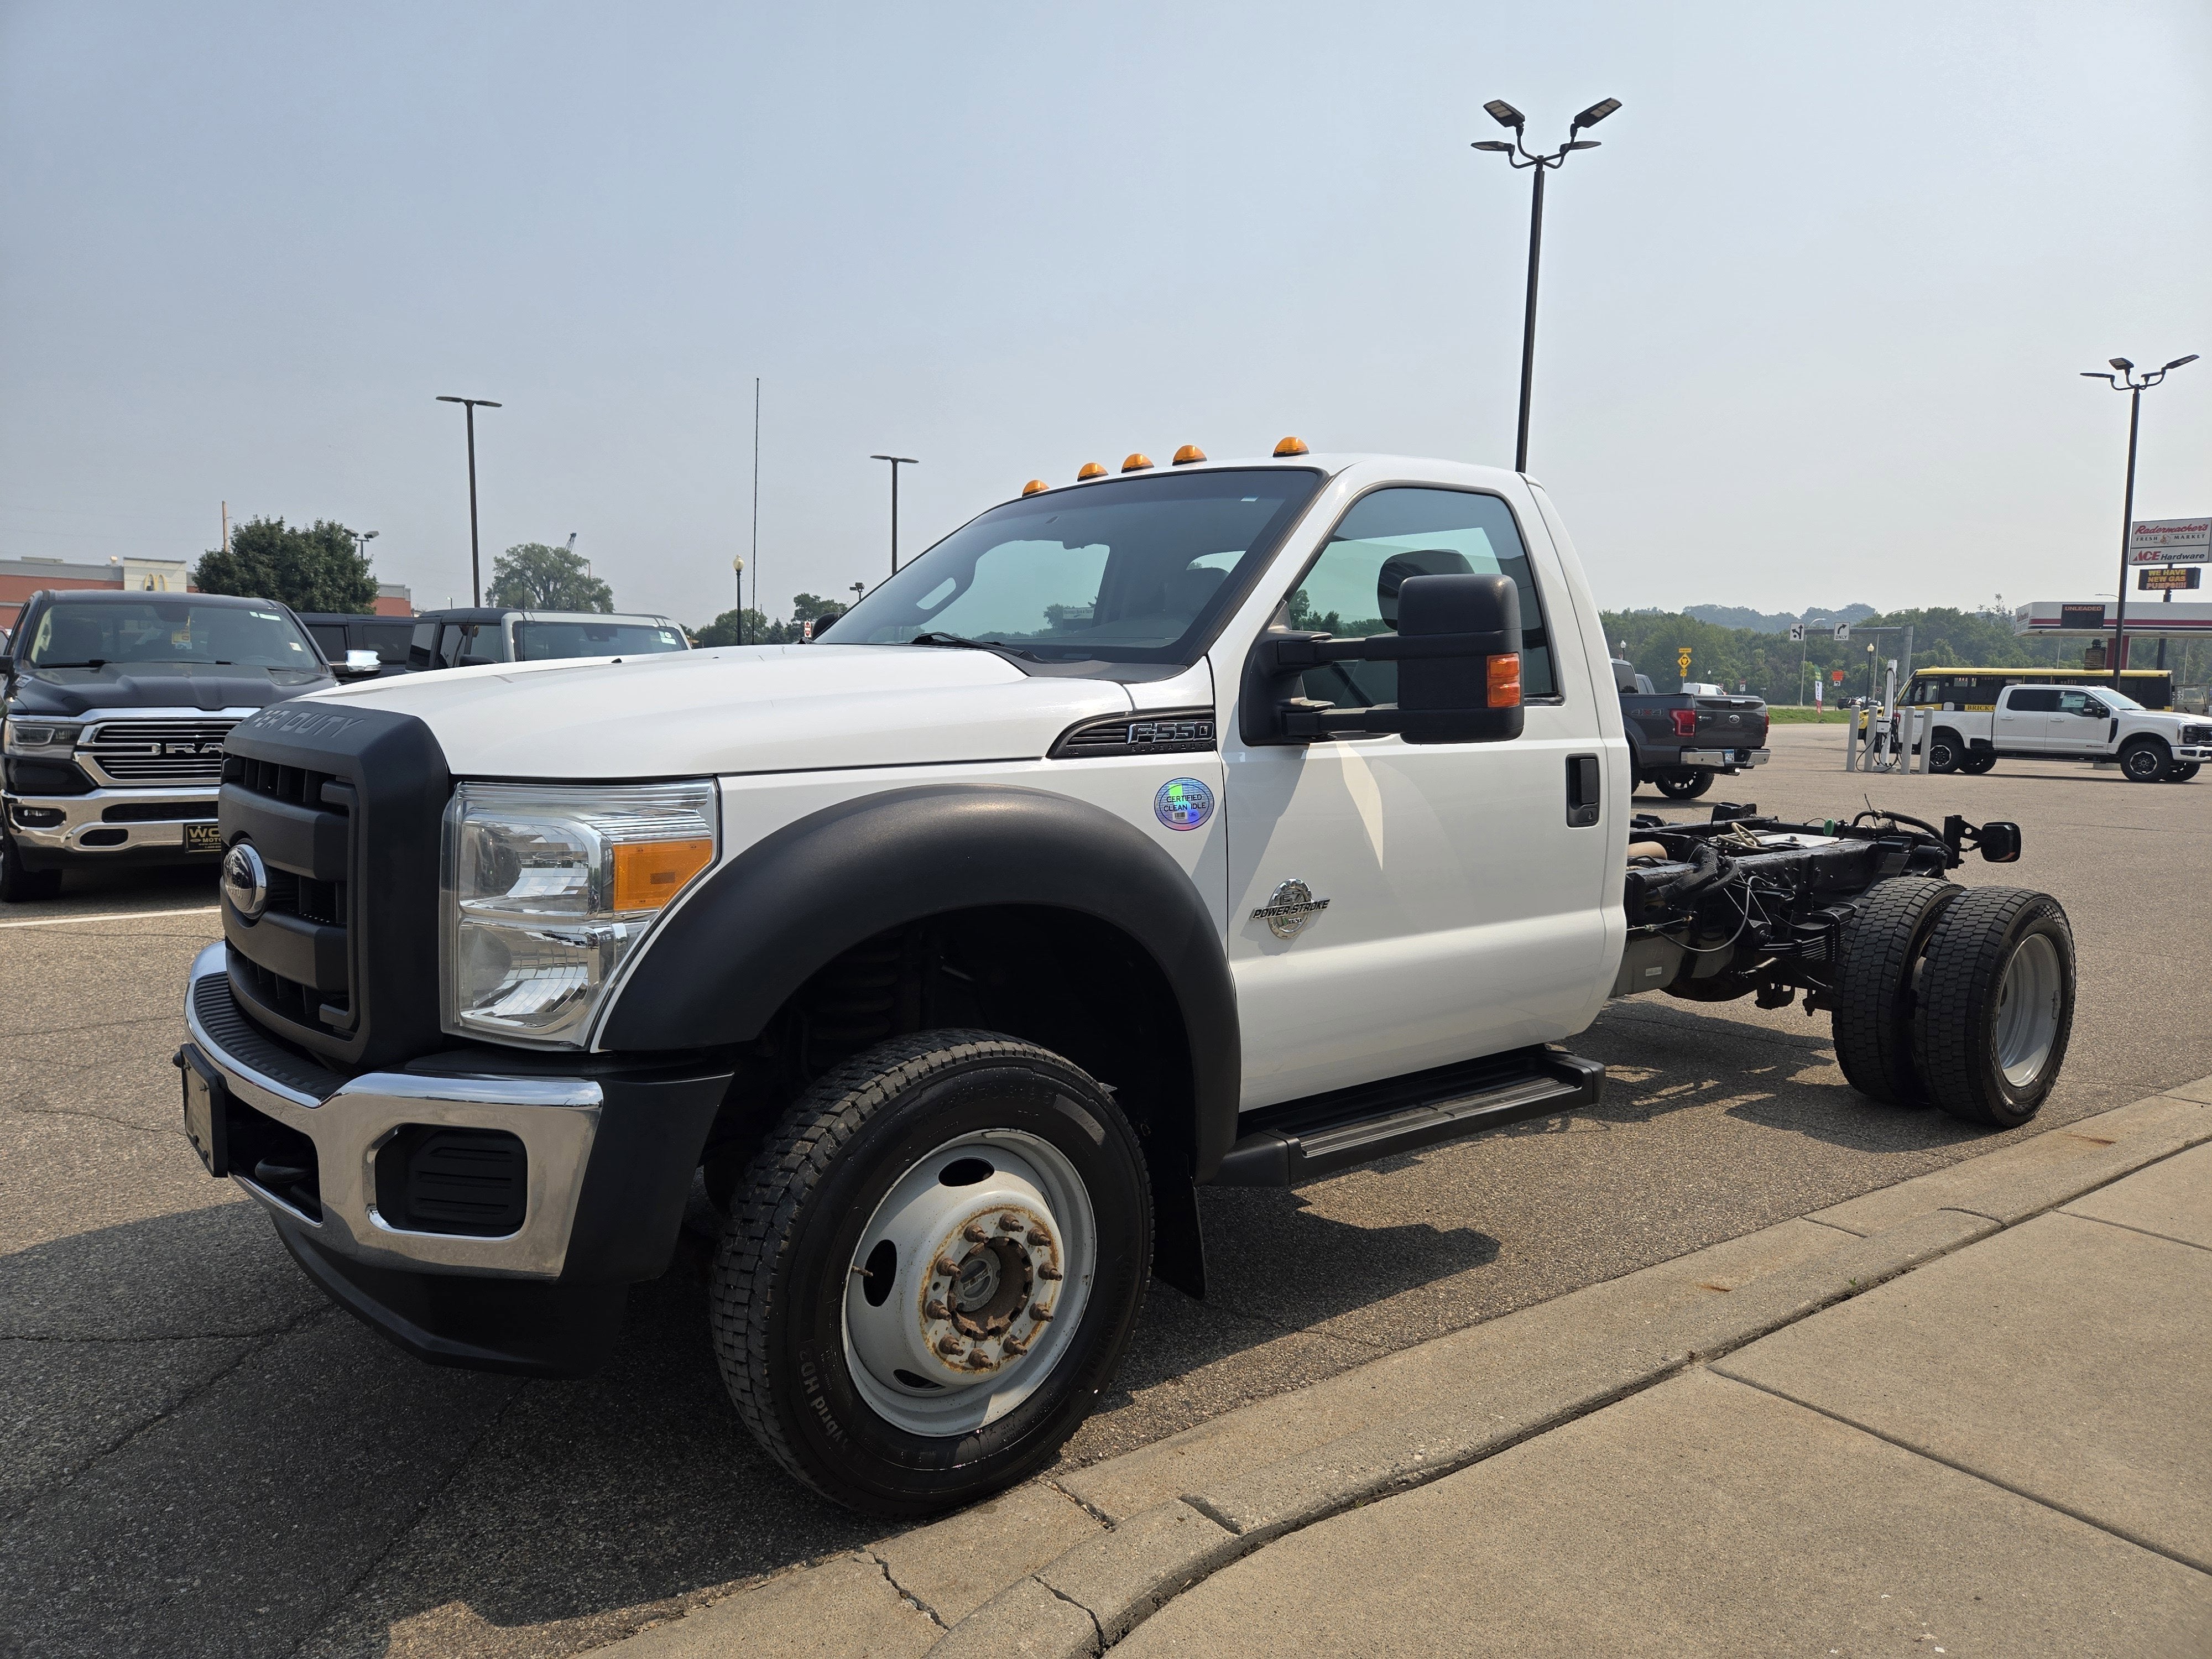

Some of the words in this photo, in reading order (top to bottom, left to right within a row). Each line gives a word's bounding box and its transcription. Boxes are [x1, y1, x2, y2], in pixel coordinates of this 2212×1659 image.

[2135, 524, 2209, 535] Radermacher's
[2133, 550, 2161, 561] ACE
[277, 711, 366, 738] DUTY
[166, 743, 223, 753] RA
[1166, 794, 1202, 803] CERTIFIED
